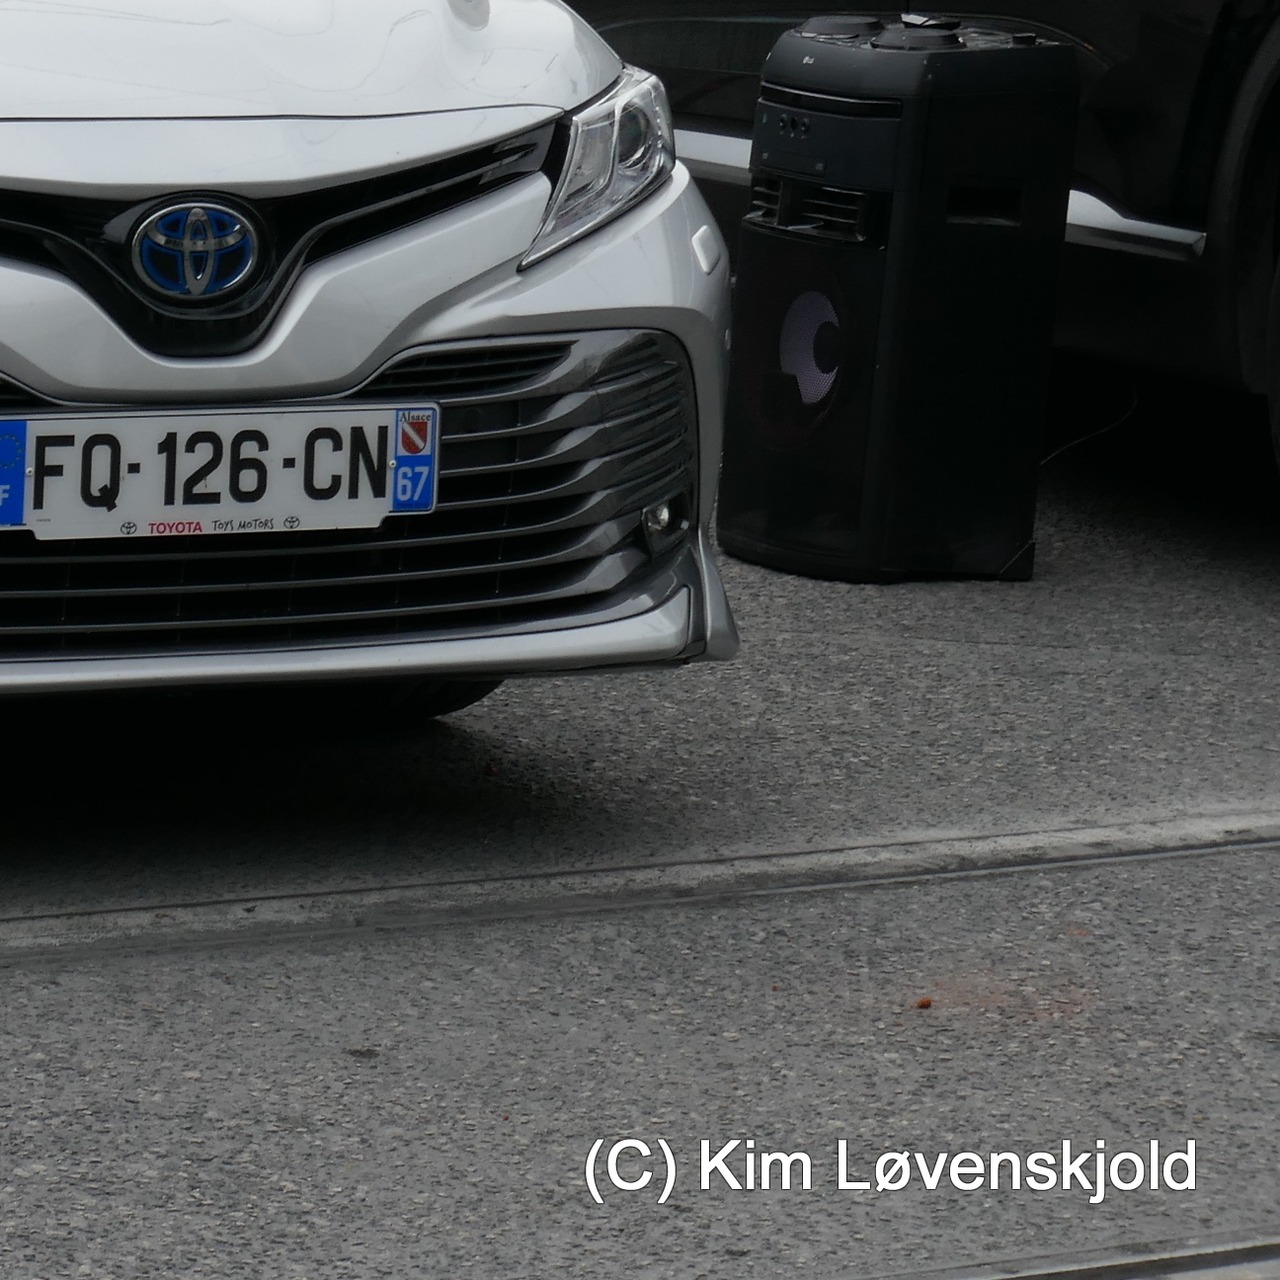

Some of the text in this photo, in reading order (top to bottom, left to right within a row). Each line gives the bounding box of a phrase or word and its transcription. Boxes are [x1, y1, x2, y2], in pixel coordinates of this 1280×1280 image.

[399, 412, 432, 422] Alsace
[32, 423, 389, 512] FQ-126-CN
[396, 465, 430, 502] 67
[148, 521, 203, 536] TOYOTA
